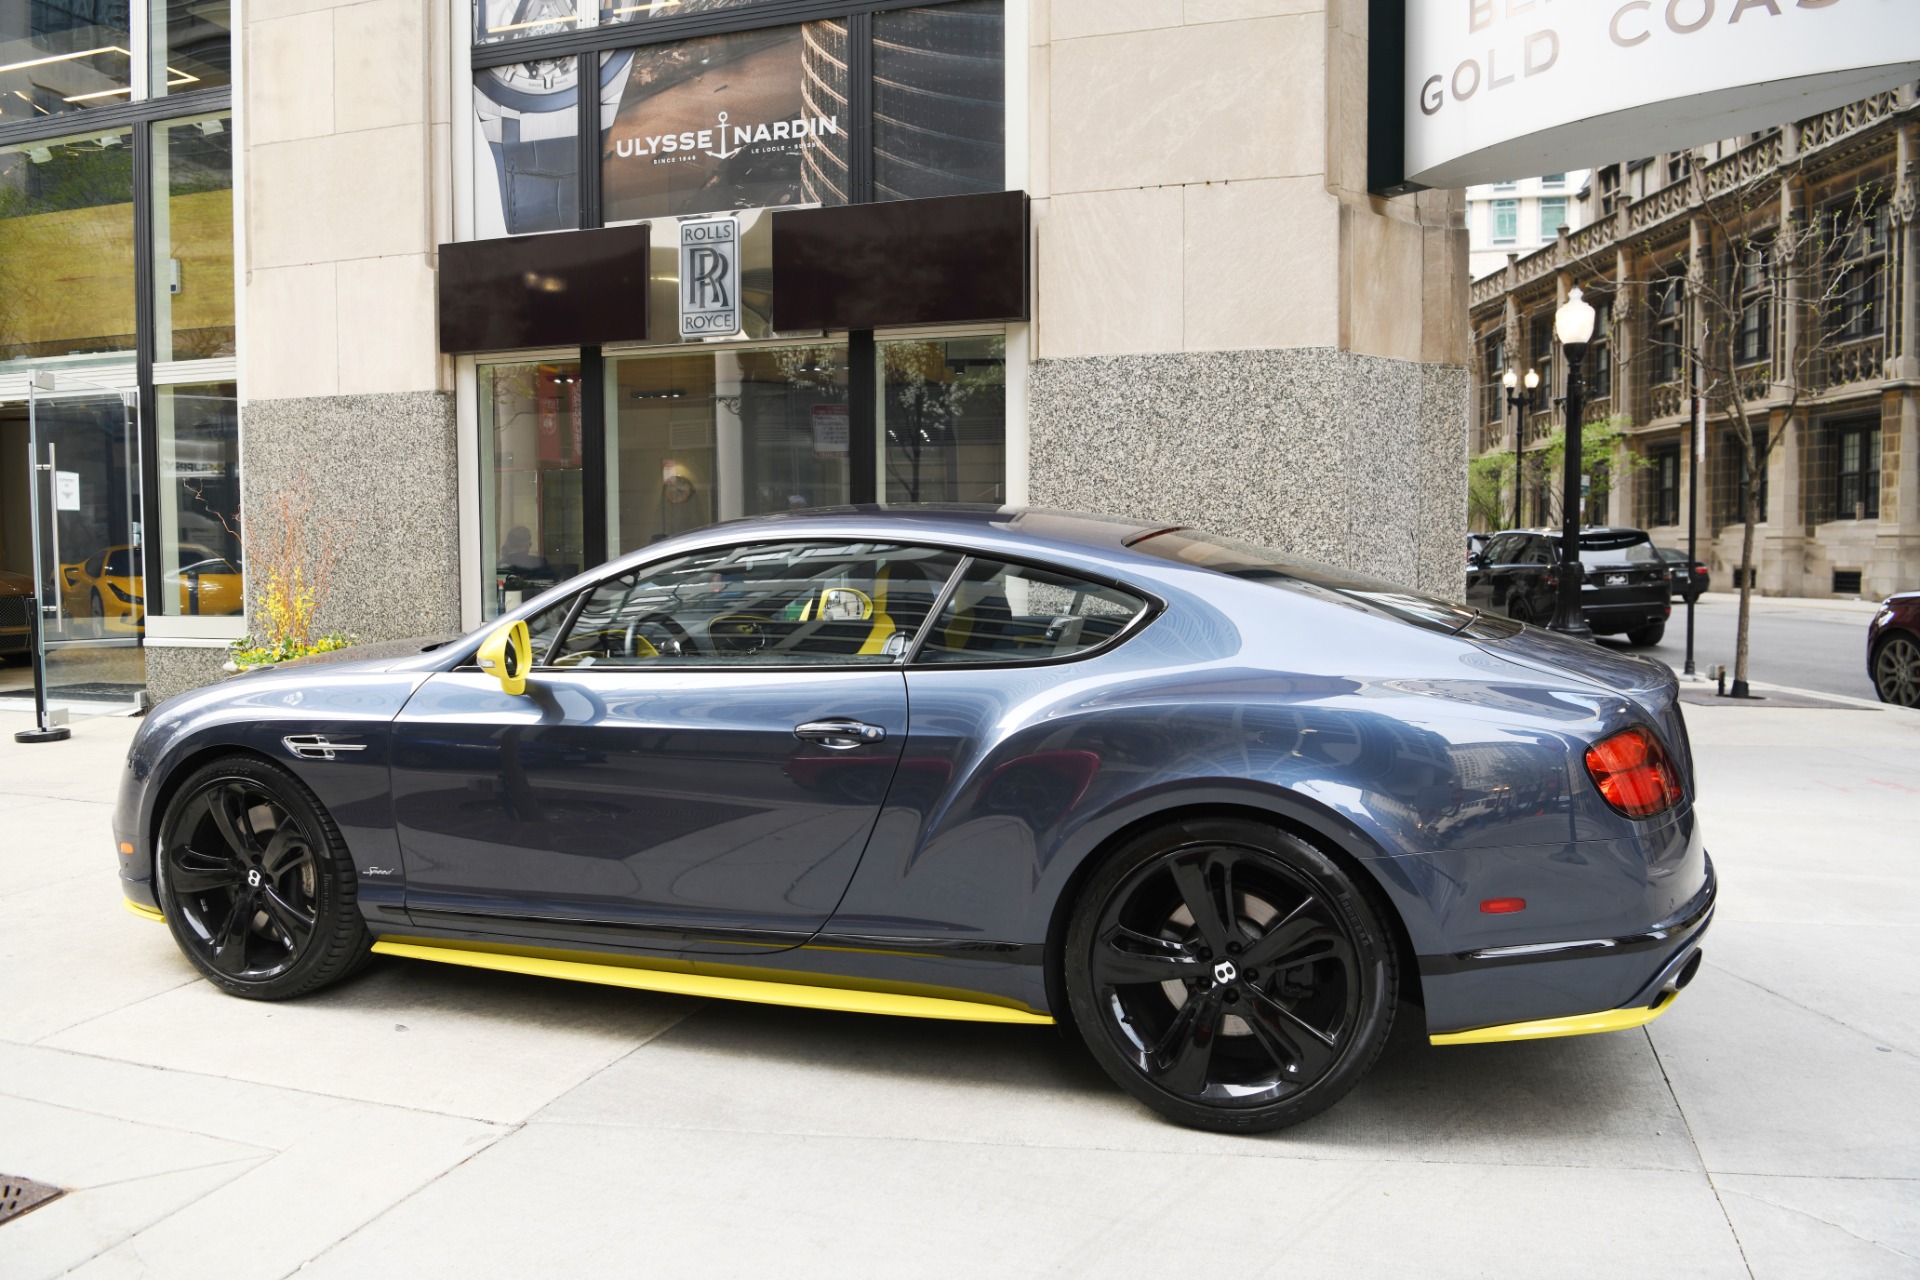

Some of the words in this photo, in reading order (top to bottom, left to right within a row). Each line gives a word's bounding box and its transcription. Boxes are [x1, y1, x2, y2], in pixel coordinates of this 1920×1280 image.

[1420, 29, 1560, 116] GOLD
[1608, 0, 1840, 48] CO
[616, 129, 713, 158] ULYSSE
[733, 115, 838, 145] NARDIN
[762, 145, 785, 153] LOCLE
[653, 157, 676, 165] SINCE
[684, 224, 731, 242] ROLLS
[685, 313, 732, 330] ROYCE
